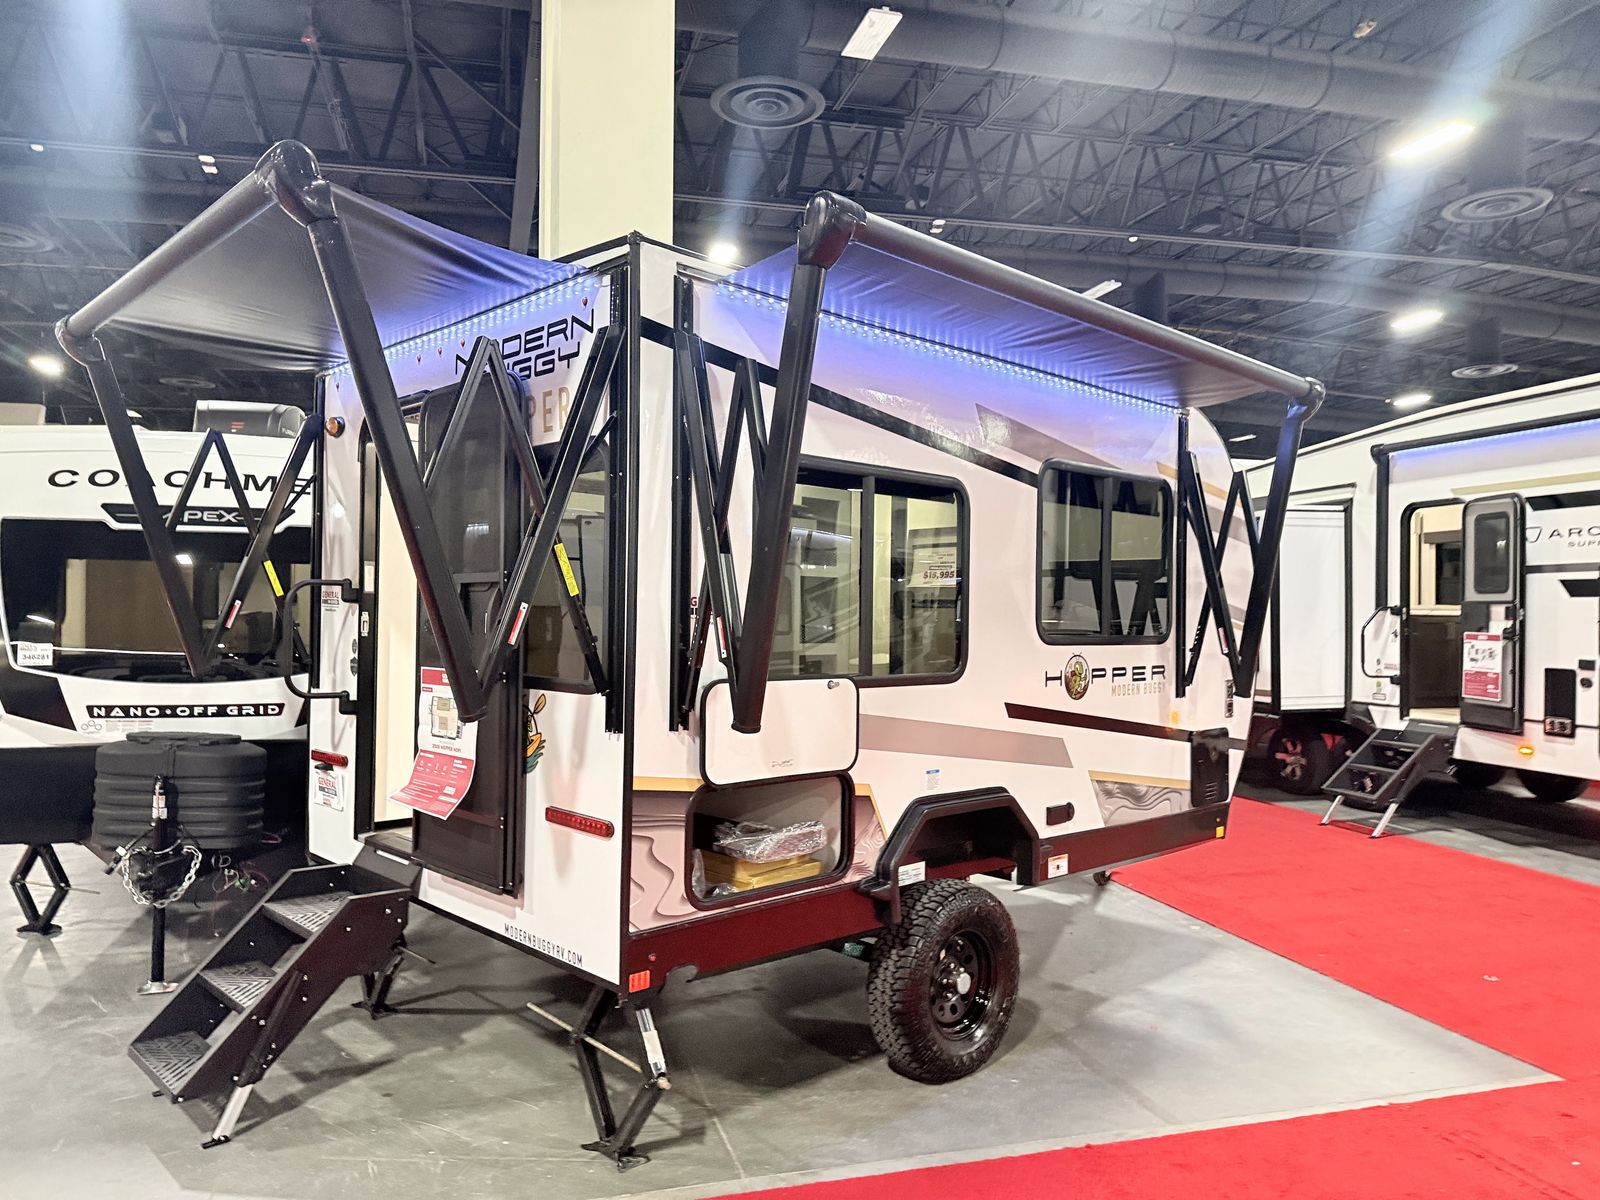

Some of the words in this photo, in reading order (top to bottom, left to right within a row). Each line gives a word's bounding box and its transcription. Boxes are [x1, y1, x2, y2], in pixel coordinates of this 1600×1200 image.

[922, 570, 955, 580] $15,995
[93, 706, 160, 717] NANO
[176, 705, 219, 717] OFF
[226, 704, 280, 716] GRID
[504, 923, 583, 967] MODERNBUGGYRV.COM
